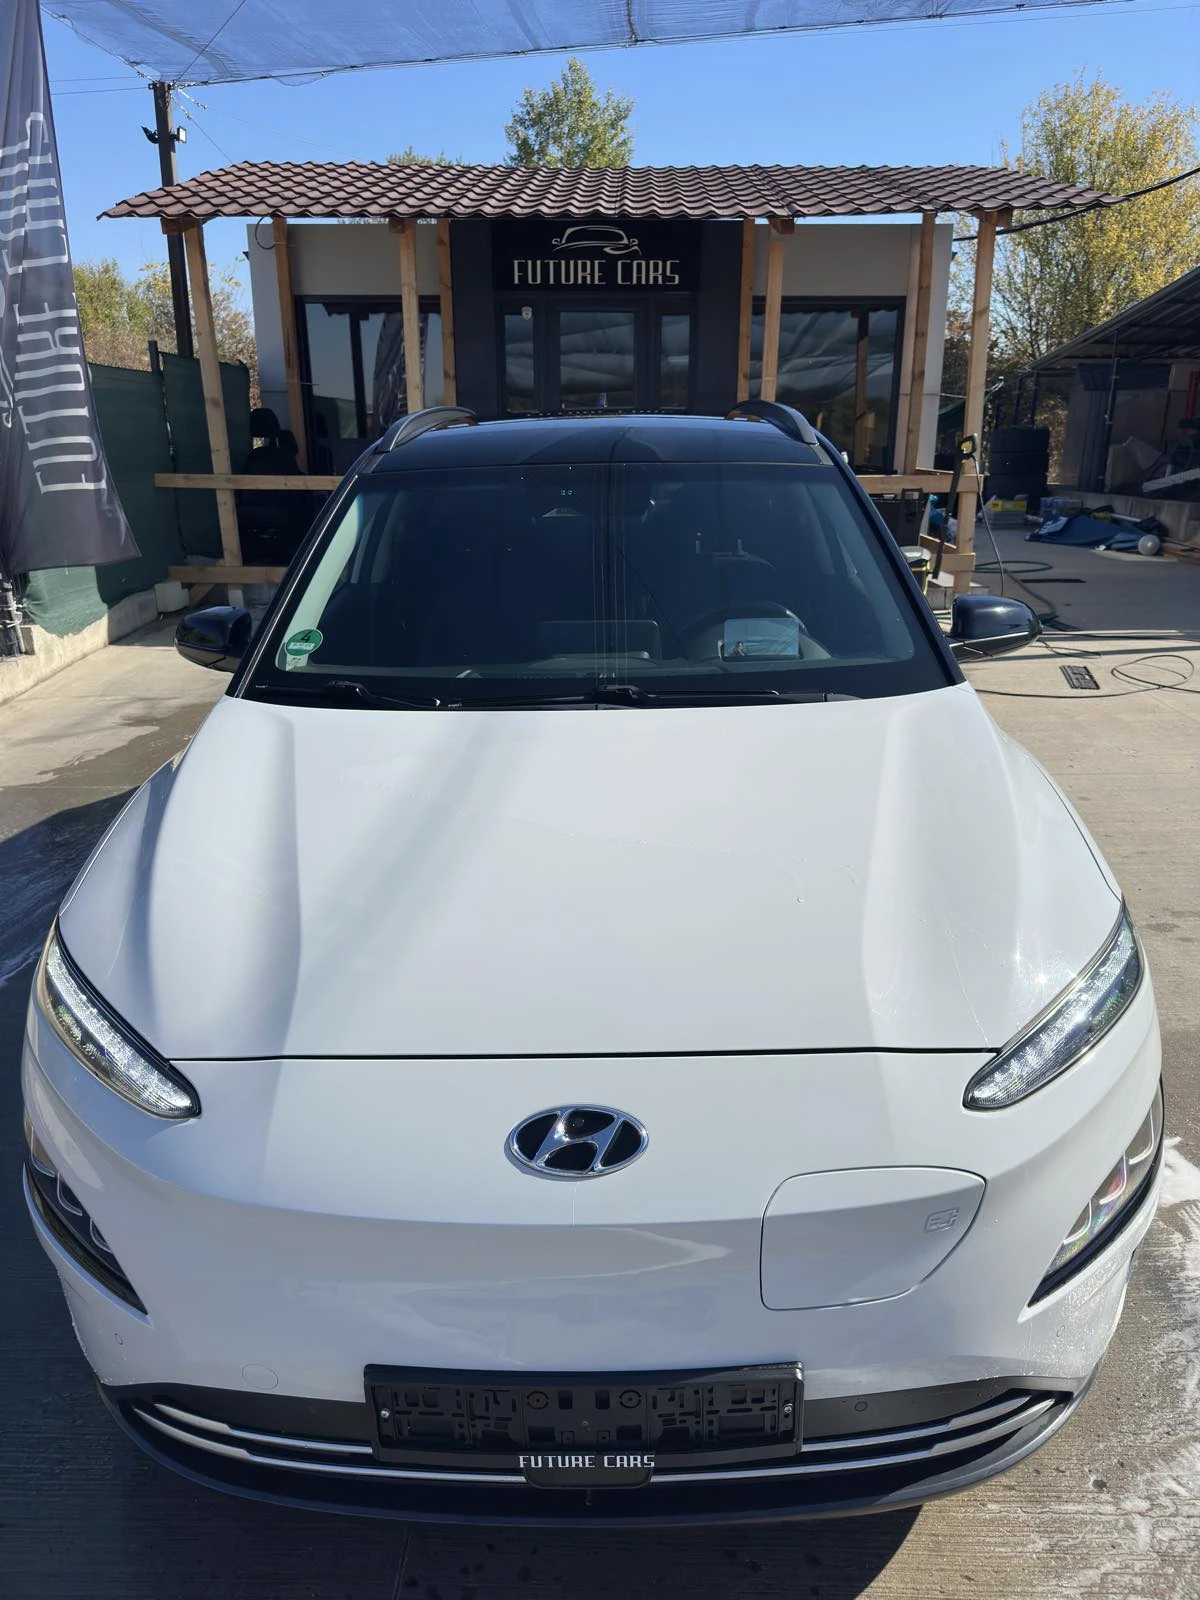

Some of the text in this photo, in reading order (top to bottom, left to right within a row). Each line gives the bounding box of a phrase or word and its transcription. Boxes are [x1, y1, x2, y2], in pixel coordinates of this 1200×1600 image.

[513, 260, 680, 285] FUTURE CARS
[300, 630, 315, 643] 4
[519, 1454, 656, 1468] FUTURE CARS
